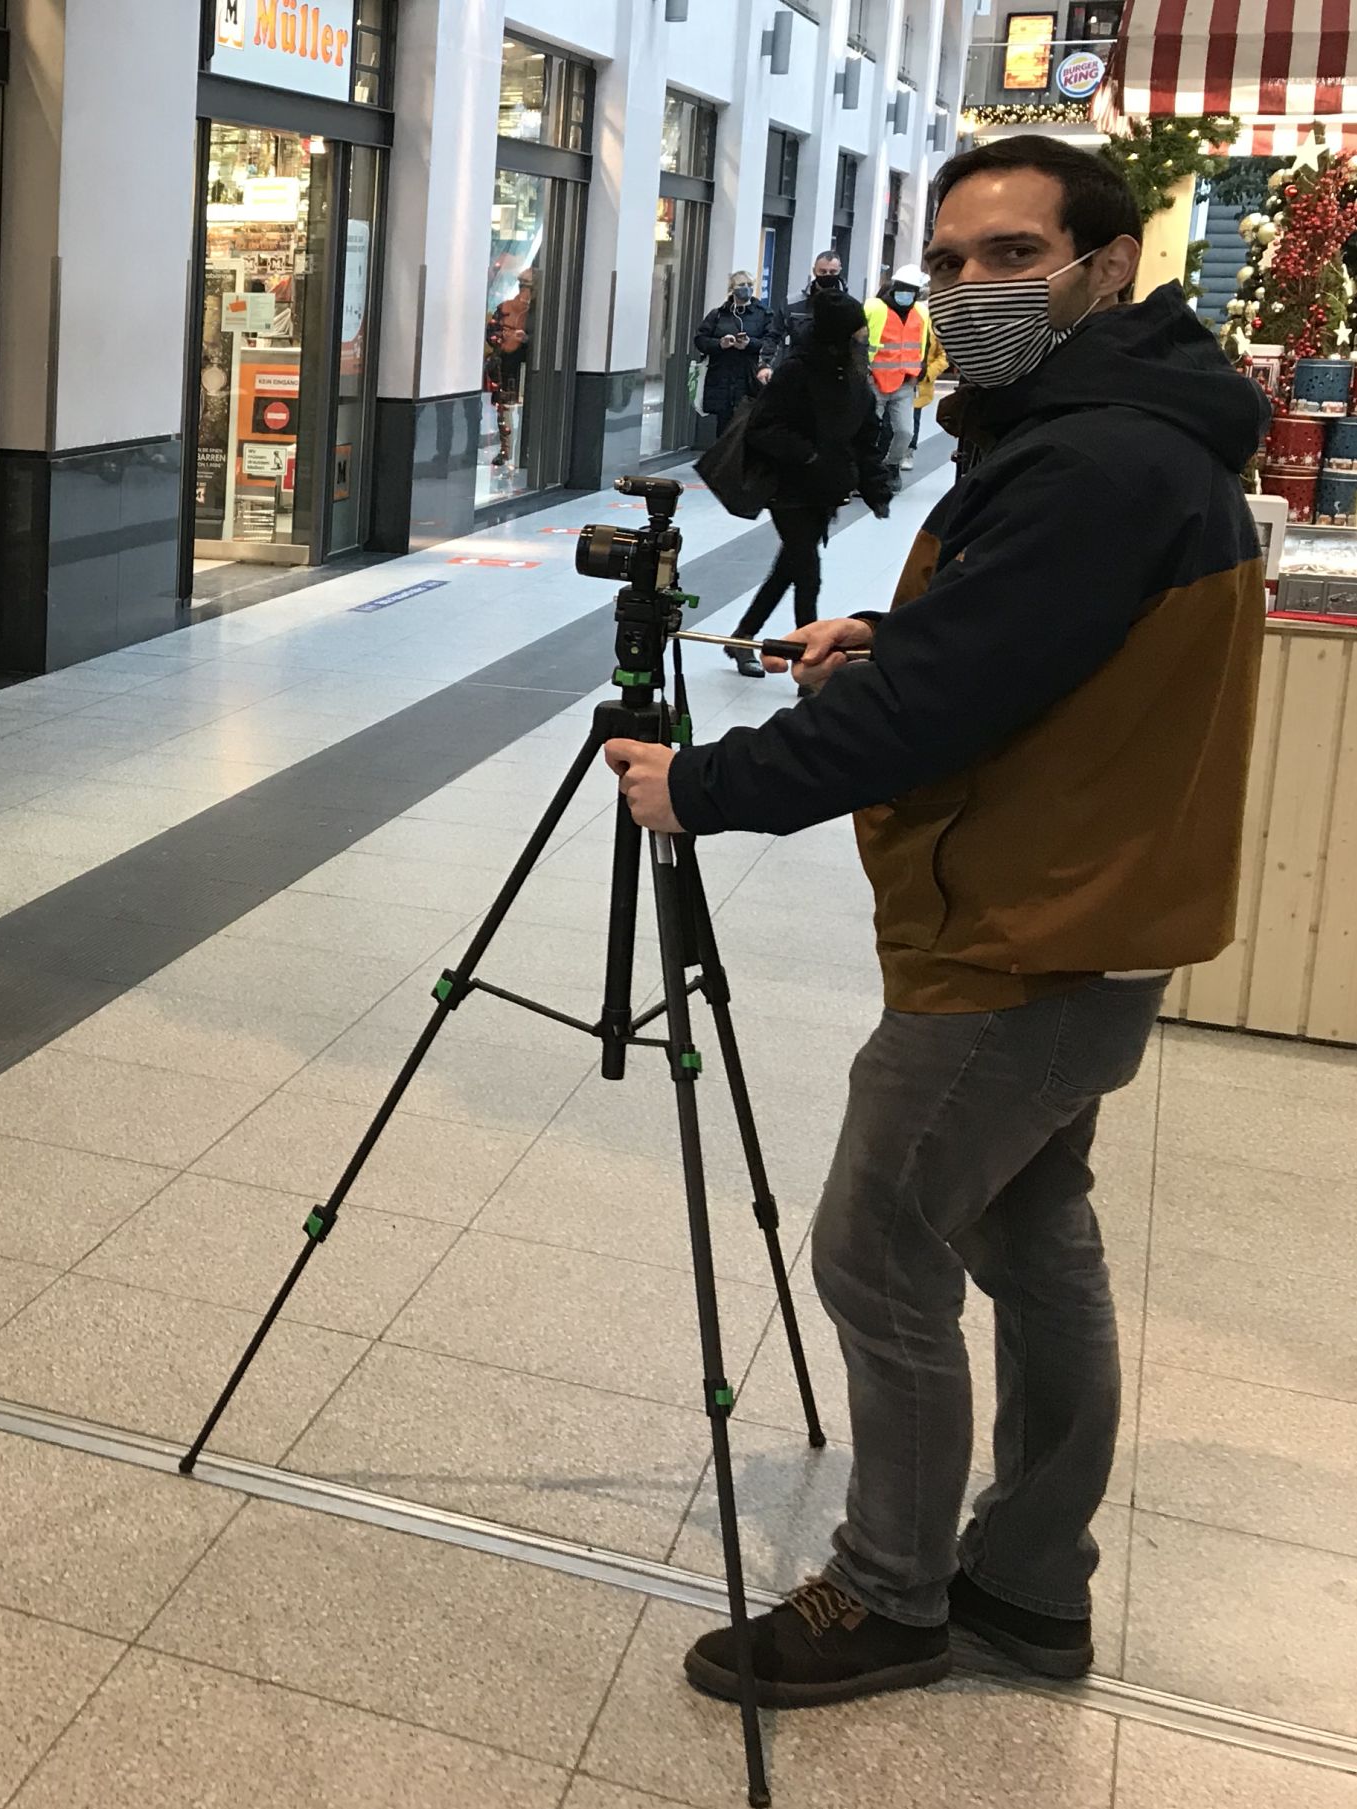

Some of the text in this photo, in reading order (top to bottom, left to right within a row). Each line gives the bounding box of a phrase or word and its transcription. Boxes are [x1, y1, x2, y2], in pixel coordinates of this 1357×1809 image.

[225, 0, 238, 25] M
[253, 0, 348, 67] Müller
[1063, 60, 1099, 77] BURGER
[1064, 68, 1099, 88] KING
